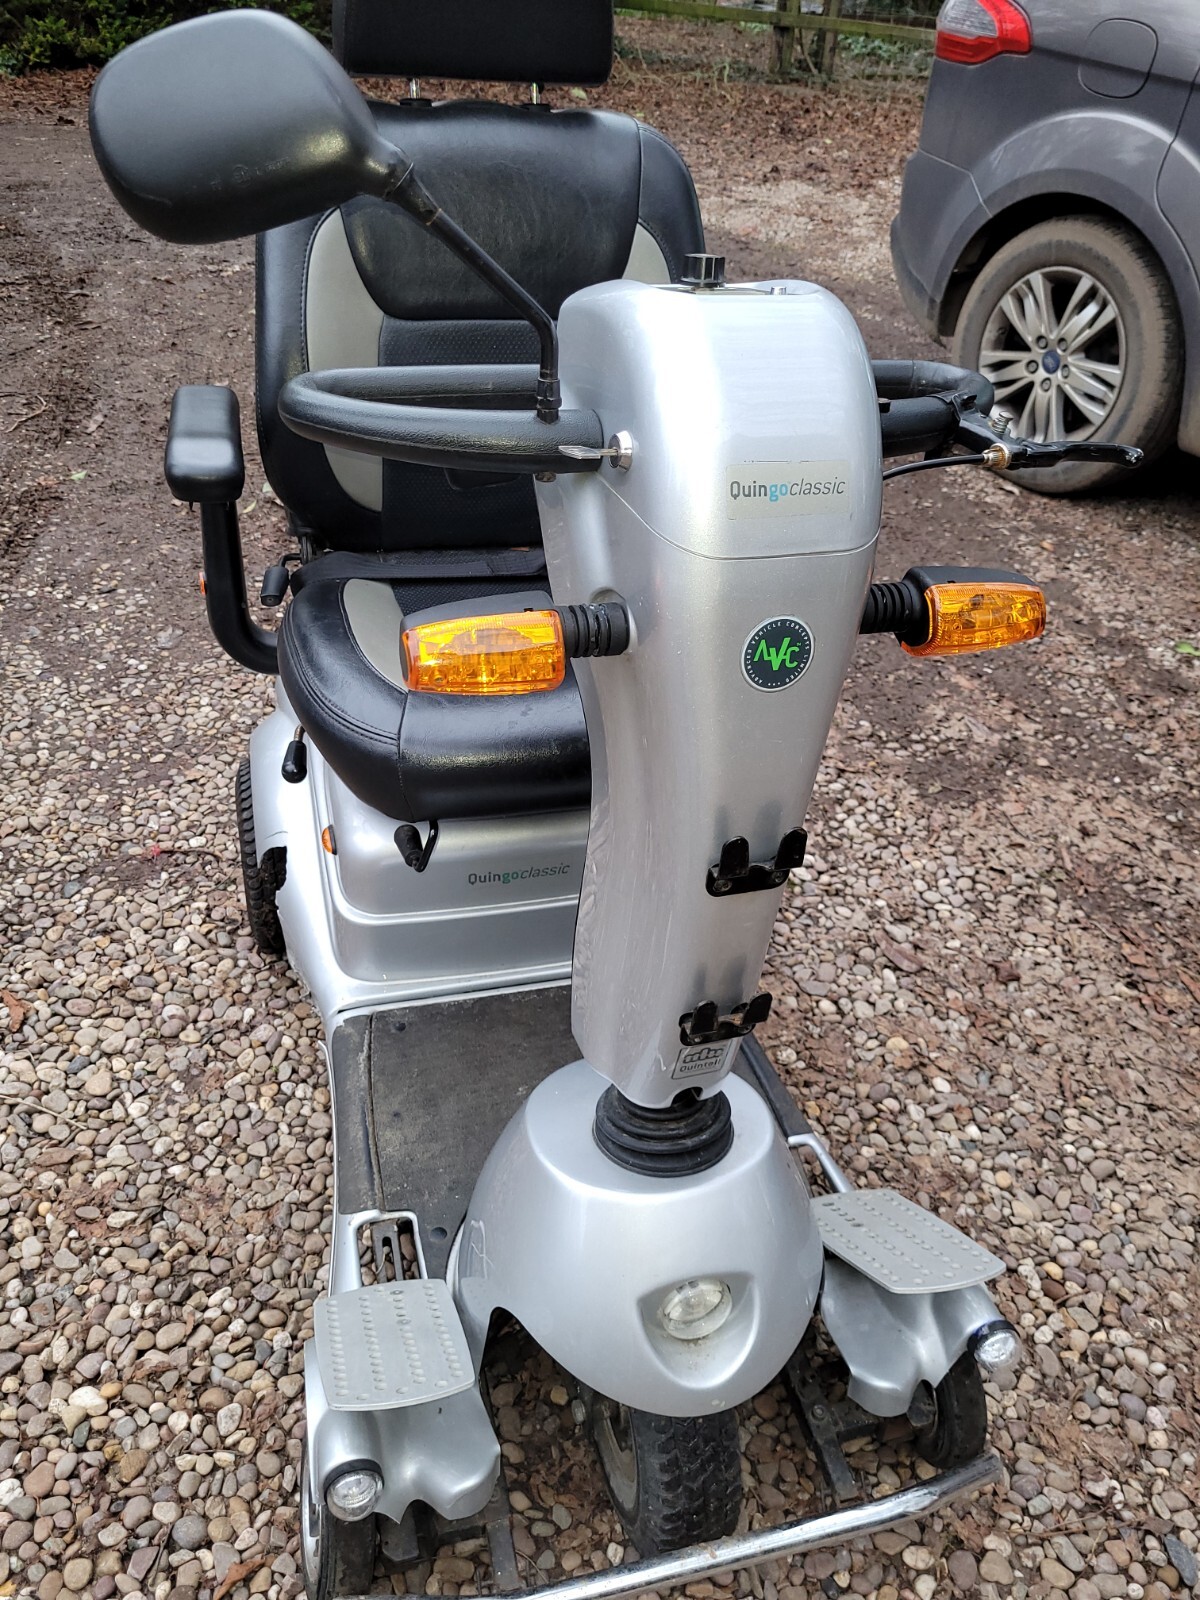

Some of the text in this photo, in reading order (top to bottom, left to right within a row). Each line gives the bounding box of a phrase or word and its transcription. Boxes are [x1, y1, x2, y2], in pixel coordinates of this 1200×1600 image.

[750, 621, 782, 645] VEHICLE
[786, 621, 810, 650] CONCEPTS
[785, 654, 809, 683] LIMITED
